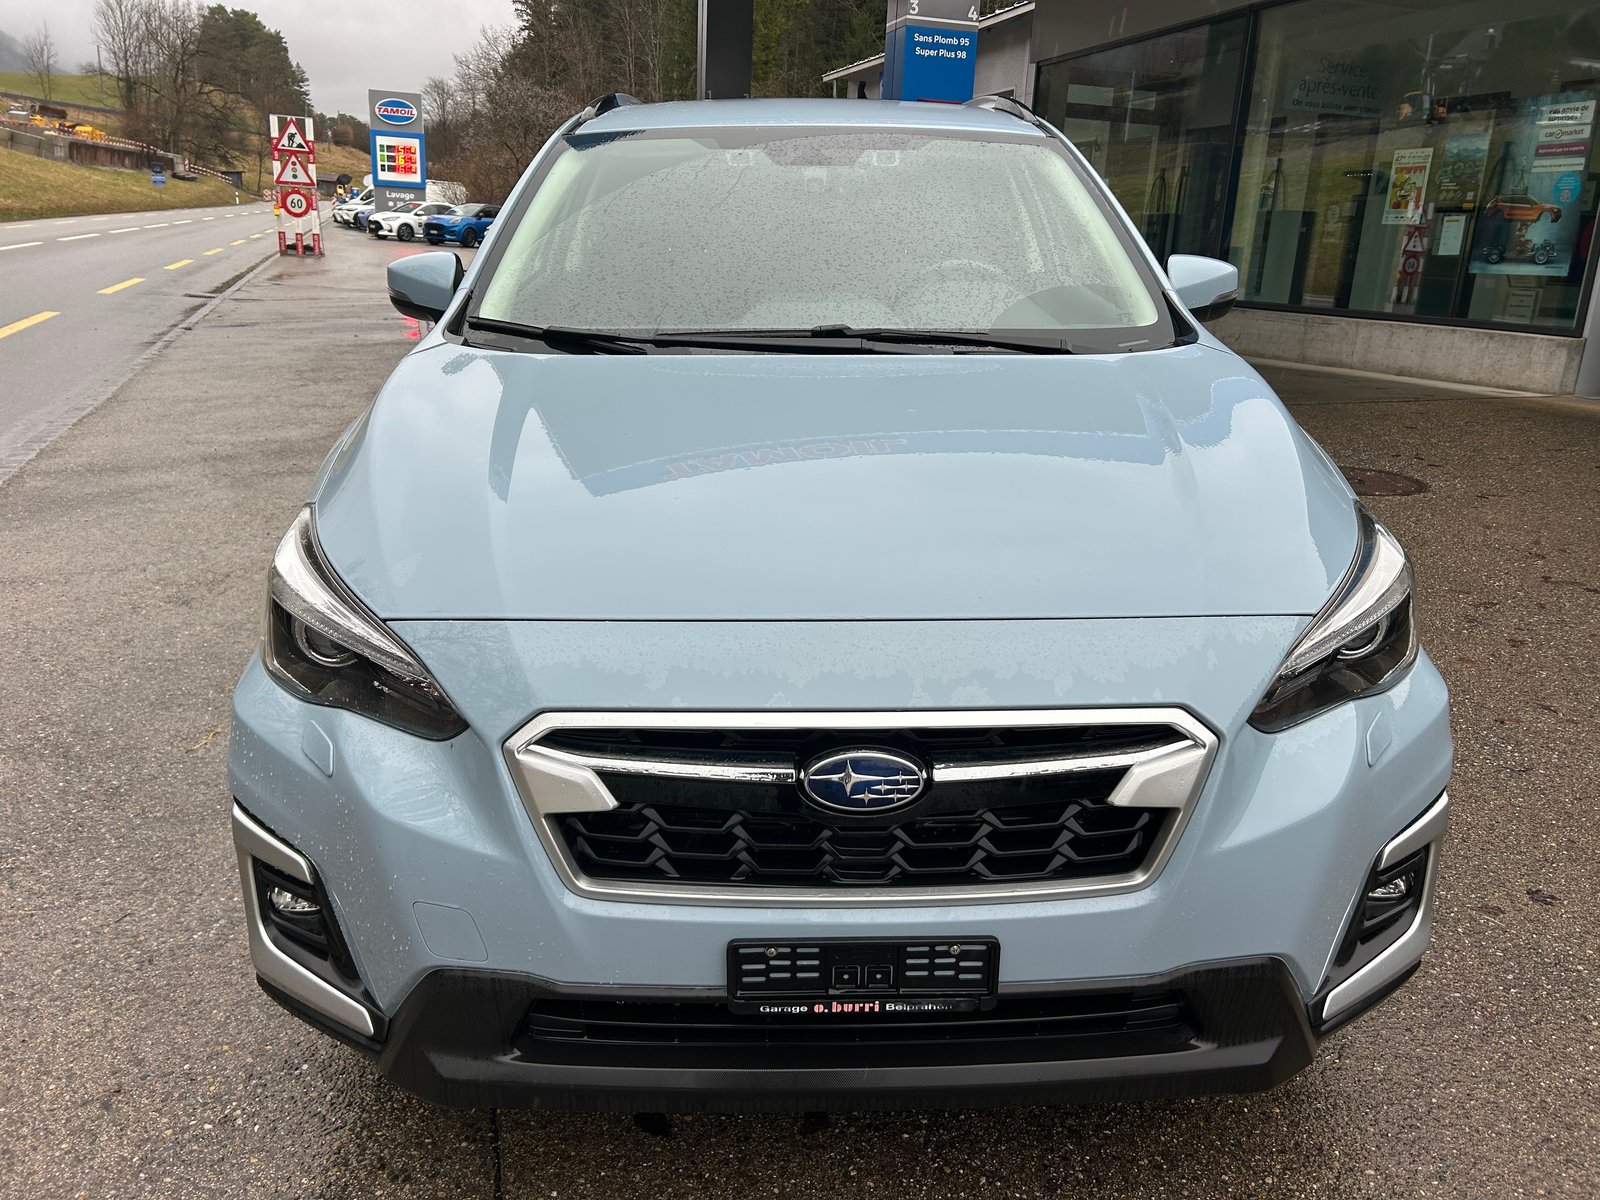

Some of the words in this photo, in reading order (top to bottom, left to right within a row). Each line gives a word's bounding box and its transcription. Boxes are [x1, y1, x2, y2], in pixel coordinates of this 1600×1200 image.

[909, 0, 919, 14] 3
[967, 6, 978, 21] 4
[914, 33, 933, 43] Sans
[933, 35, 959, 45] Plomb
[959, 37, 970, 46] 95
[915, 47, 938, 57] Super
[939, 49, 956, 58] Plus
[956, 50, 967, 59] 98
[1319, 57, 1368, 77] Service
[1299, 78, 1380, 99] après-vente
[376, 106, 416, 117] TAMOIL
[1580, 104, 1590, 112] de
[386, 190, 415, 200] Lavage
[290, 198, 303, 209] 60
[760, 1005, 808, 1014] Garage
[832, 1001, 880, 1013] burri
